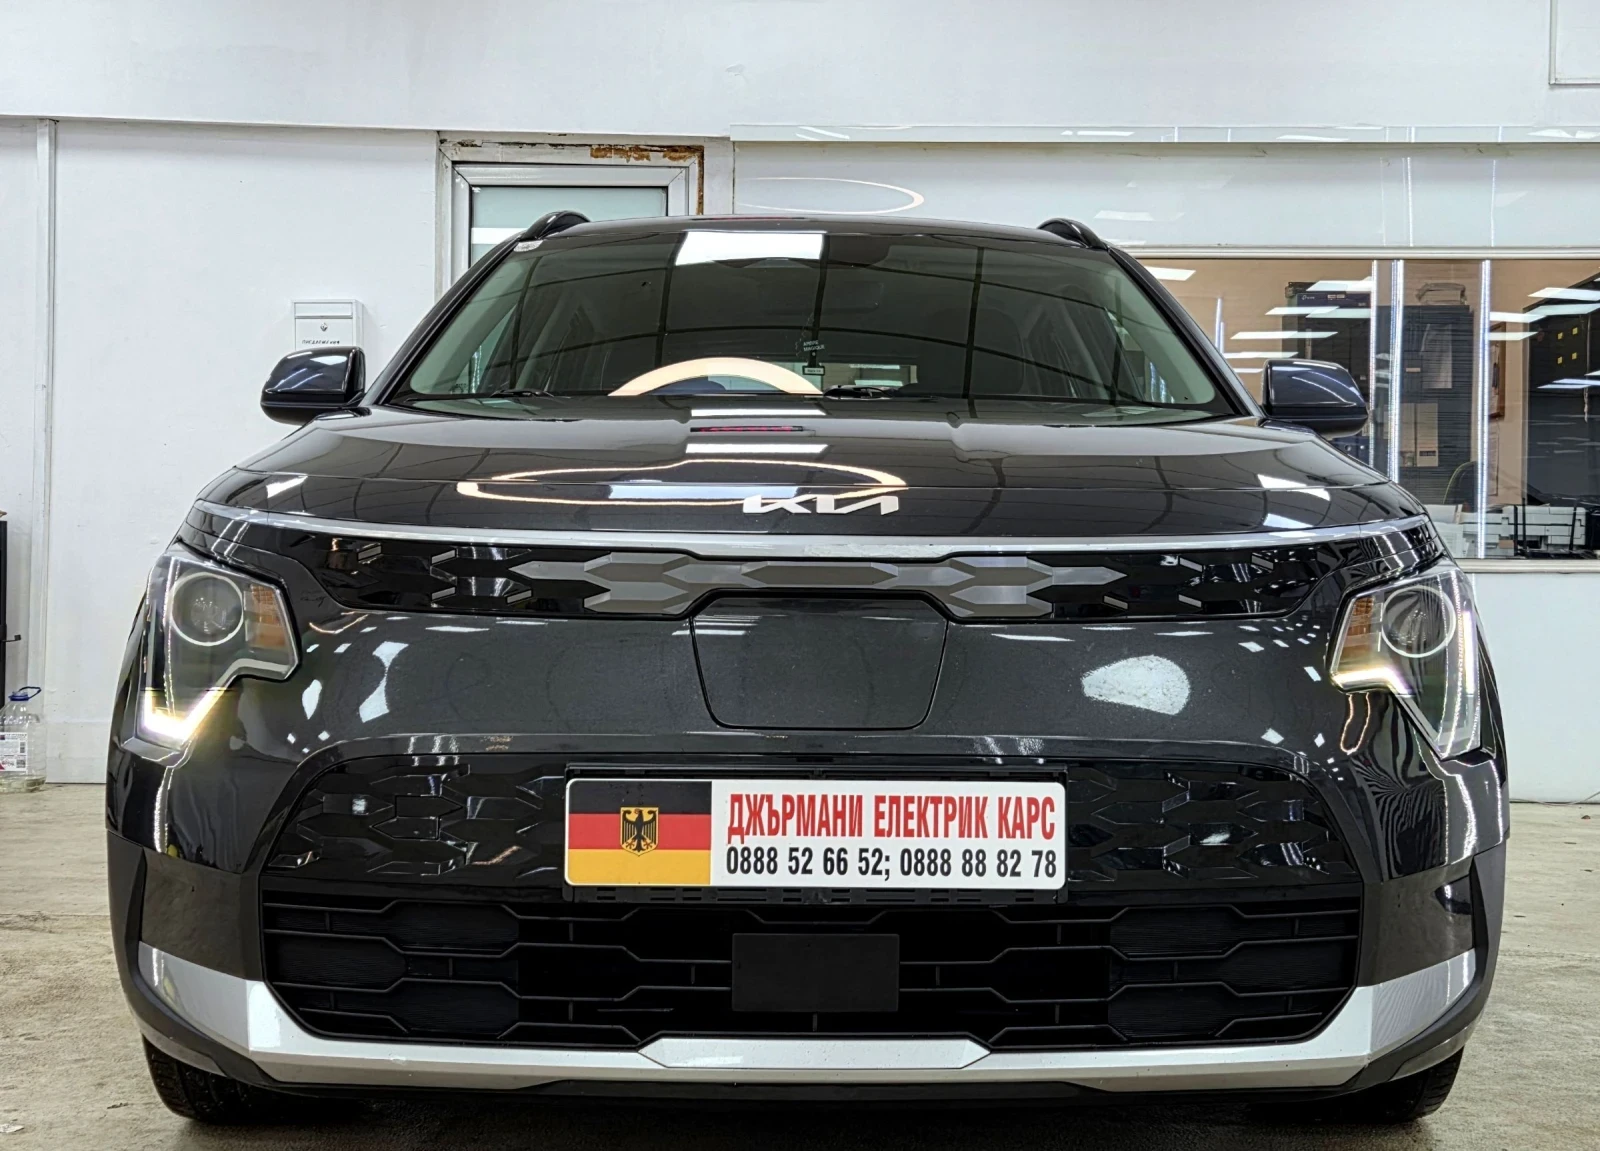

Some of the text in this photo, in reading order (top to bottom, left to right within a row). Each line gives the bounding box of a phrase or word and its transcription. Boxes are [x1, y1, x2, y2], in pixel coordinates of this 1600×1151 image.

[743, 494, 899, 515] KIA
[727, 793, 1056, 843] ДЖЪРМАНИ ЕЛЕКТРИК КАРС
[726, 846, 1057, 881] 0888 52 66 52; 0888 88 82 78
